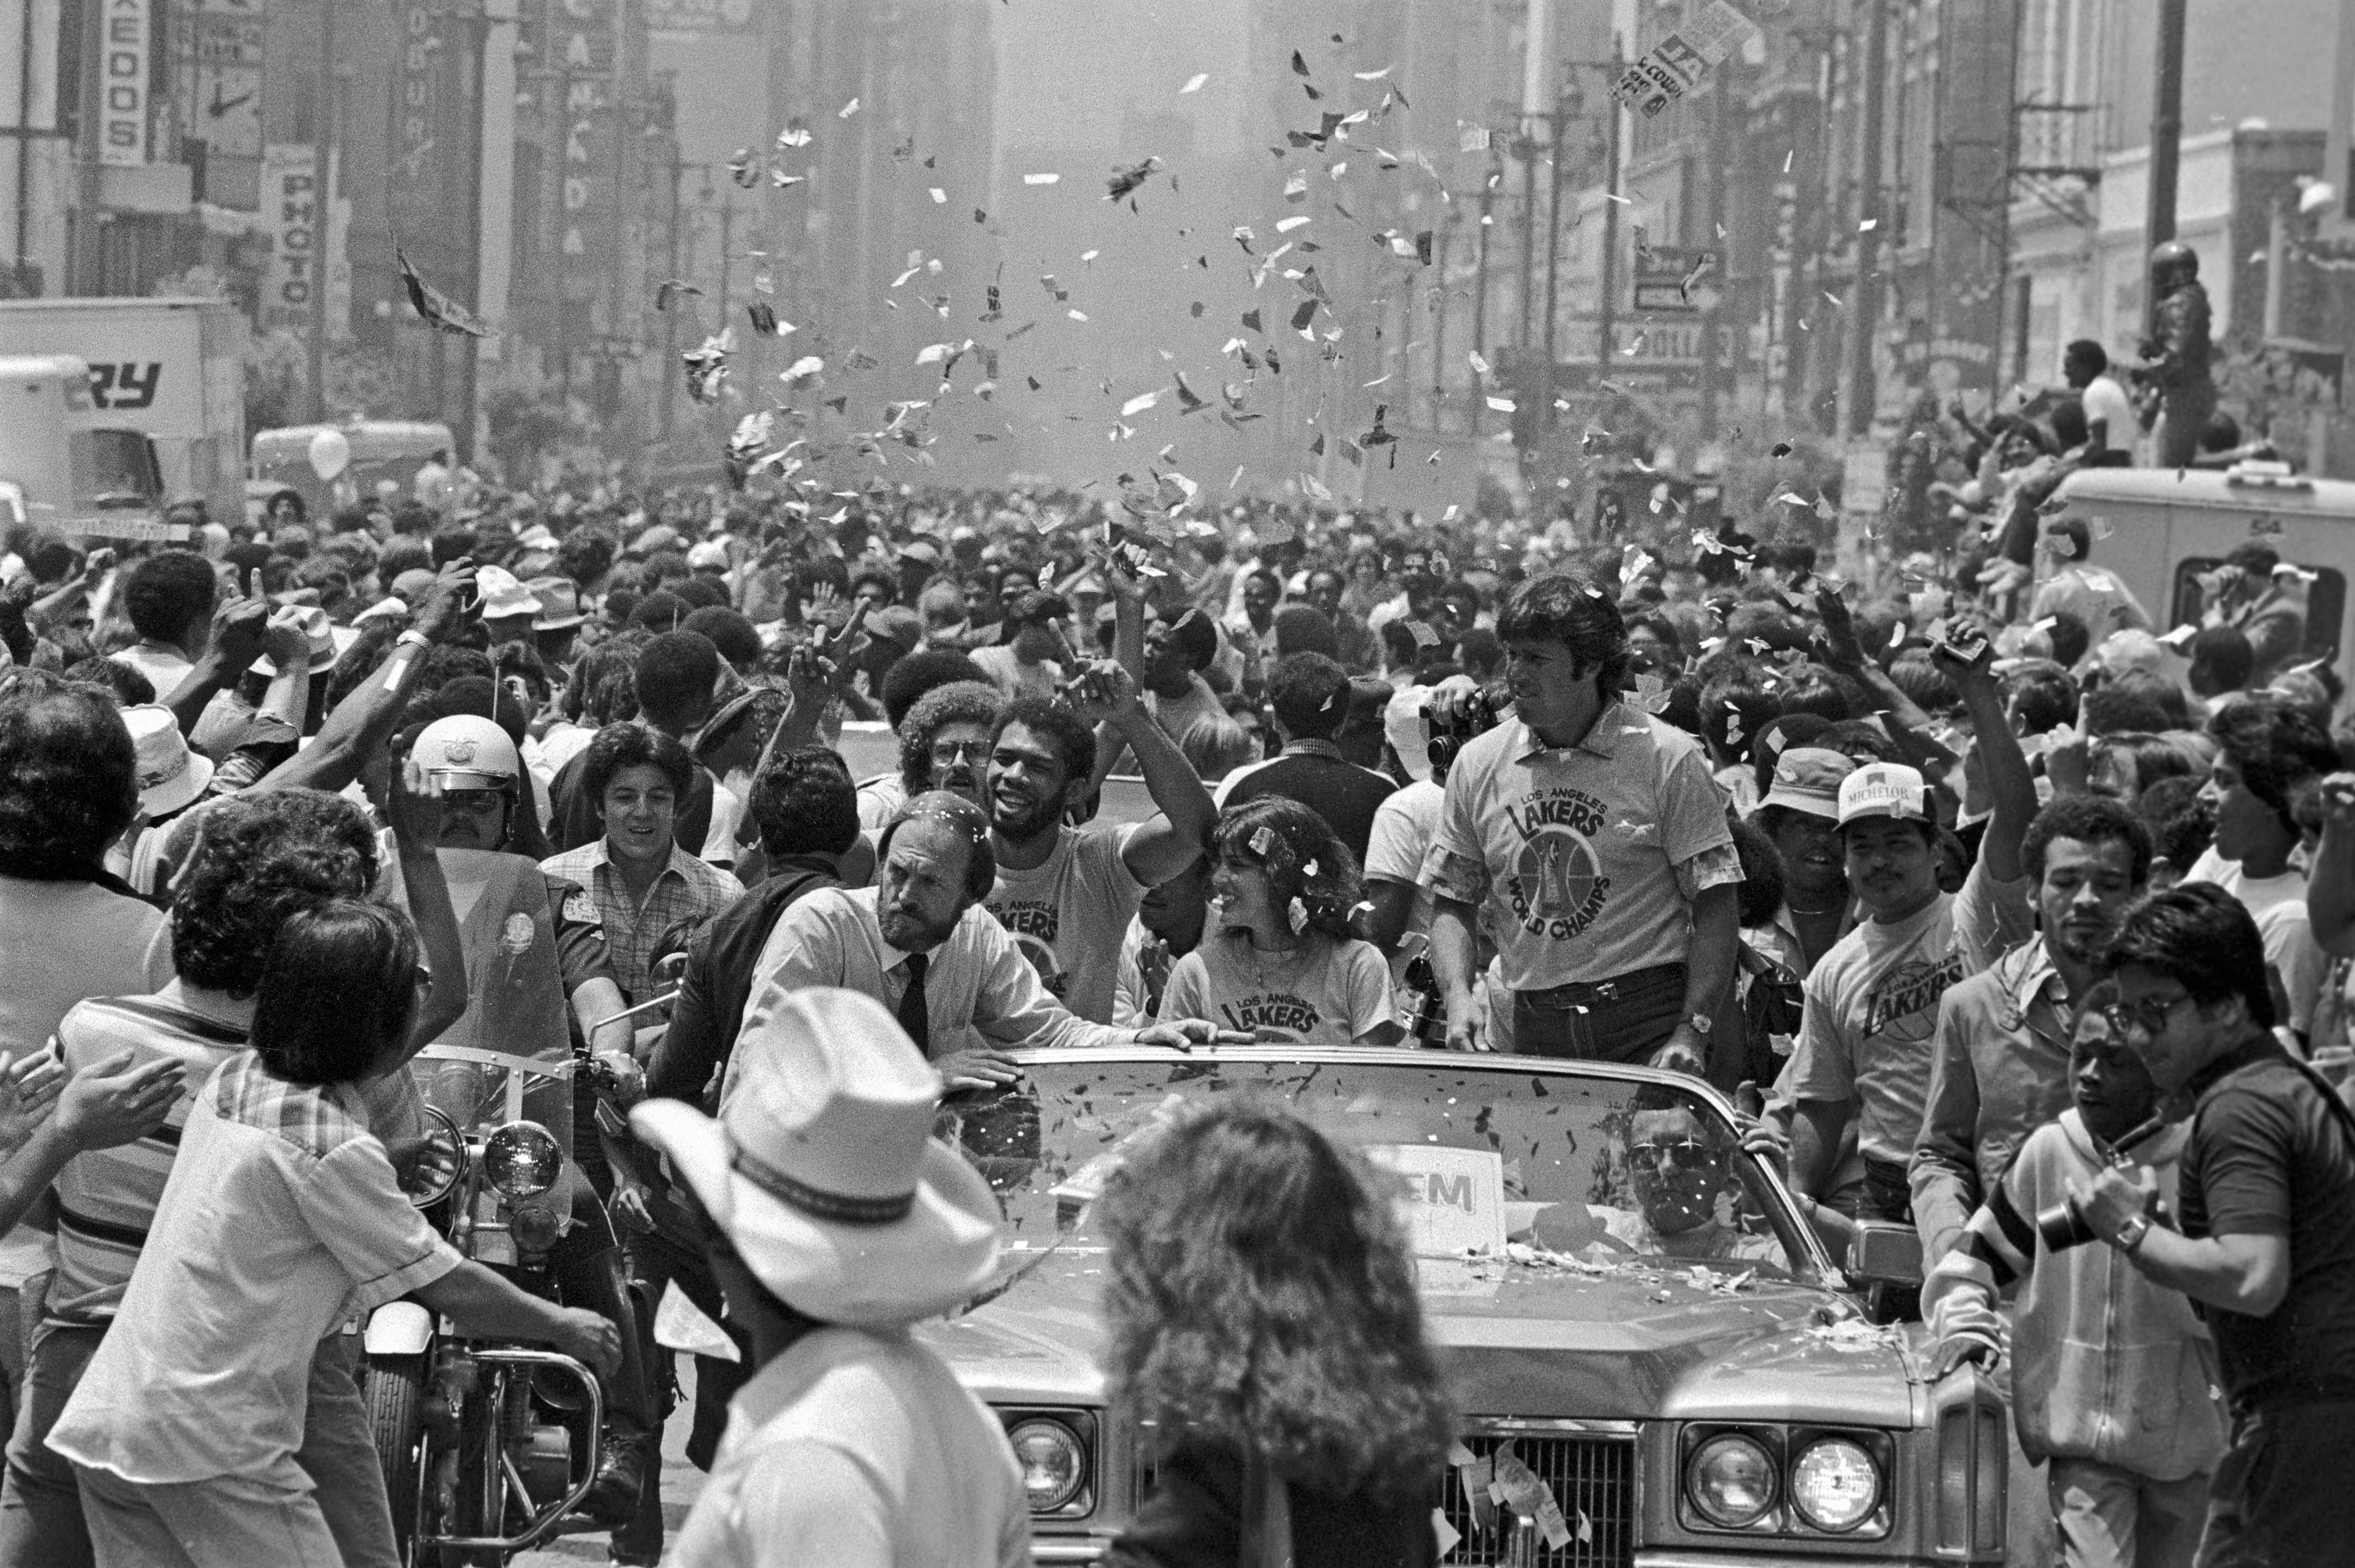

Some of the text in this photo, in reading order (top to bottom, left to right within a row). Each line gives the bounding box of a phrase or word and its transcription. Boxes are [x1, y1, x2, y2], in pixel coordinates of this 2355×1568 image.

[282, 175, 313, 303] PHOTO
[1505, 801, 1605, 841] LAKERS
[1521, 787, 1608, 815] LOS ANGELES
[1508, 876, 1545, 936] WORLD
[1550, 877, 1611, 941] CHAMPS
[1000, 911, 1059, 943] KERS
[1221, 1003, 1319, 1033] LAKERS
[1235, 995, 1261, 1009] LOS
[1861, 963, 1963, 1040] LAKERS
